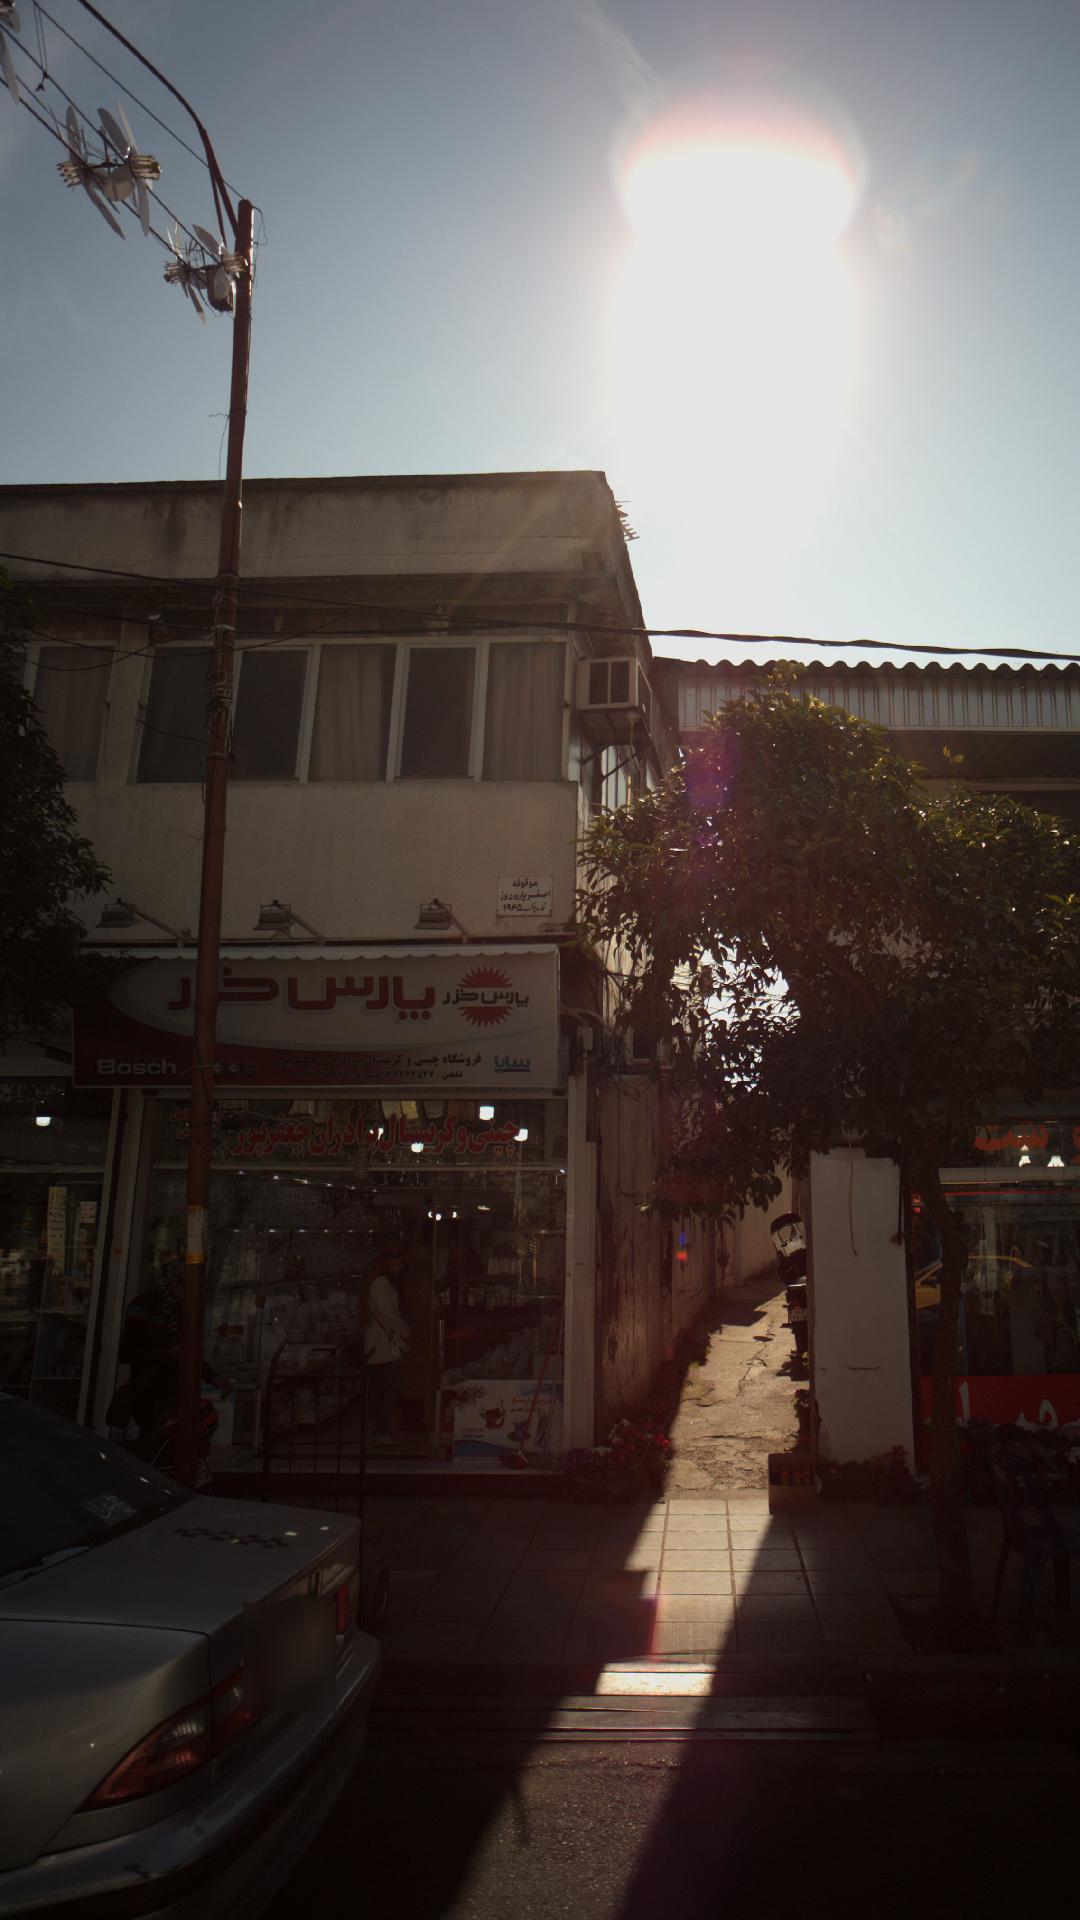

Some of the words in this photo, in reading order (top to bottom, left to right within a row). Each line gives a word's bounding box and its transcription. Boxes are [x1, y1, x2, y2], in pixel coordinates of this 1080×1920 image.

[512, 878, 538, 888] موقوفه
[167, 966, 280, 1011] خر
[442, 988, 479, 1005] خزر
[288, 975, 436, 1021] پارس
[481, 990, 530, 1008] پارس
[96, 1058, 177, 1076] Bosch
[364, 1053, 403, 1067] کریستال
[414, 1055, 440, 1067] چینی
[442, 1053, 482, 1067] فروشگاه
[231, 1113, 311, 1156] جعفرپور
[467, 1118, 520, 1157] چینی
